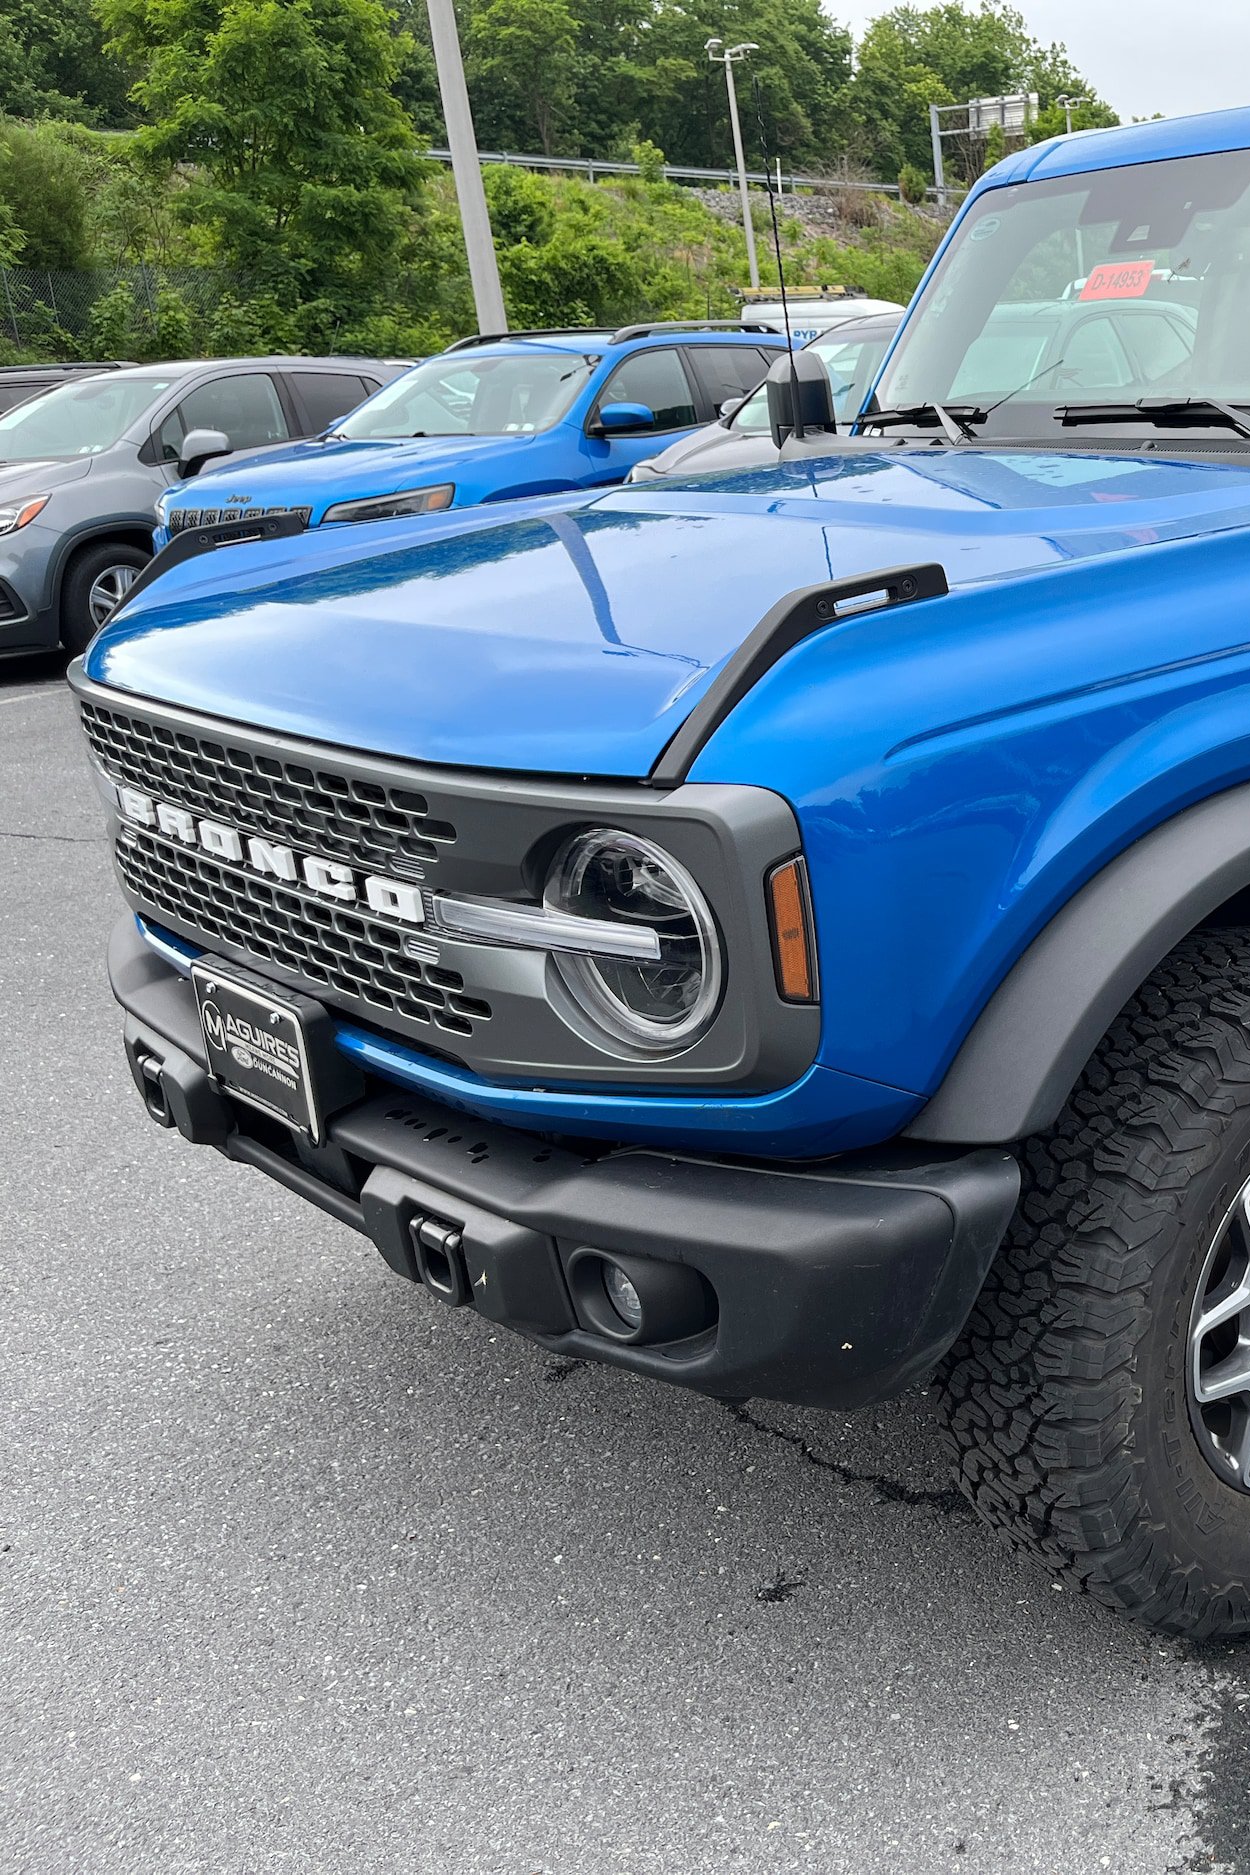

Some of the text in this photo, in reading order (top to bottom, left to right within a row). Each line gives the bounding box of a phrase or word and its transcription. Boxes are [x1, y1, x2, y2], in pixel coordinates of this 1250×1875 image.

[1091, 269, 1145, 291] D-14953
[793, 330, 826, 340] PYR
[119, 785, 425, 923] BRONCO
[253, 1056, 297, 1091] DUNCANNON
